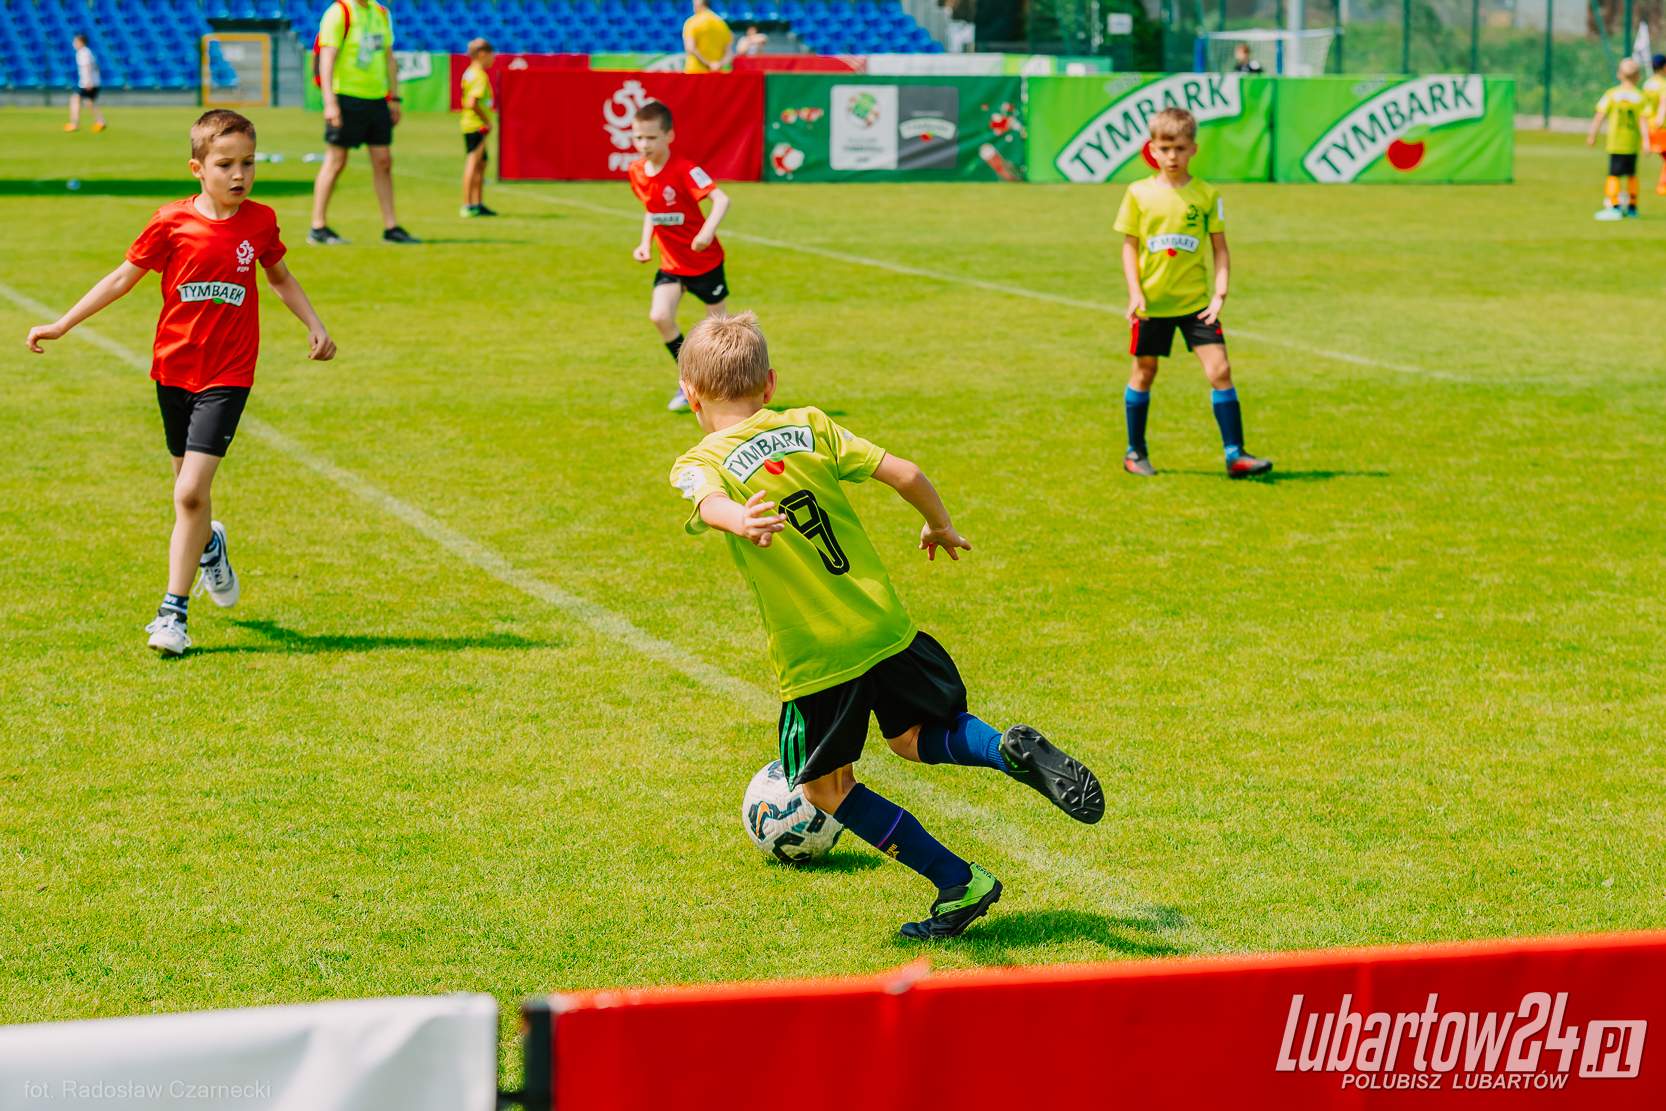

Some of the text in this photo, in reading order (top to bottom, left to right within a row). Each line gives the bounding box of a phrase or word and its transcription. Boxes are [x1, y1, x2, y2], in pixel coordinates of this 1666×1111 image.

[1070, 76, 1230, 175] TYMBARK
[1317, 76, 1473, 175] TYMBARK
[727, 430, 809, 479] TYMBARK
[778, 489, 851, 576] 9
